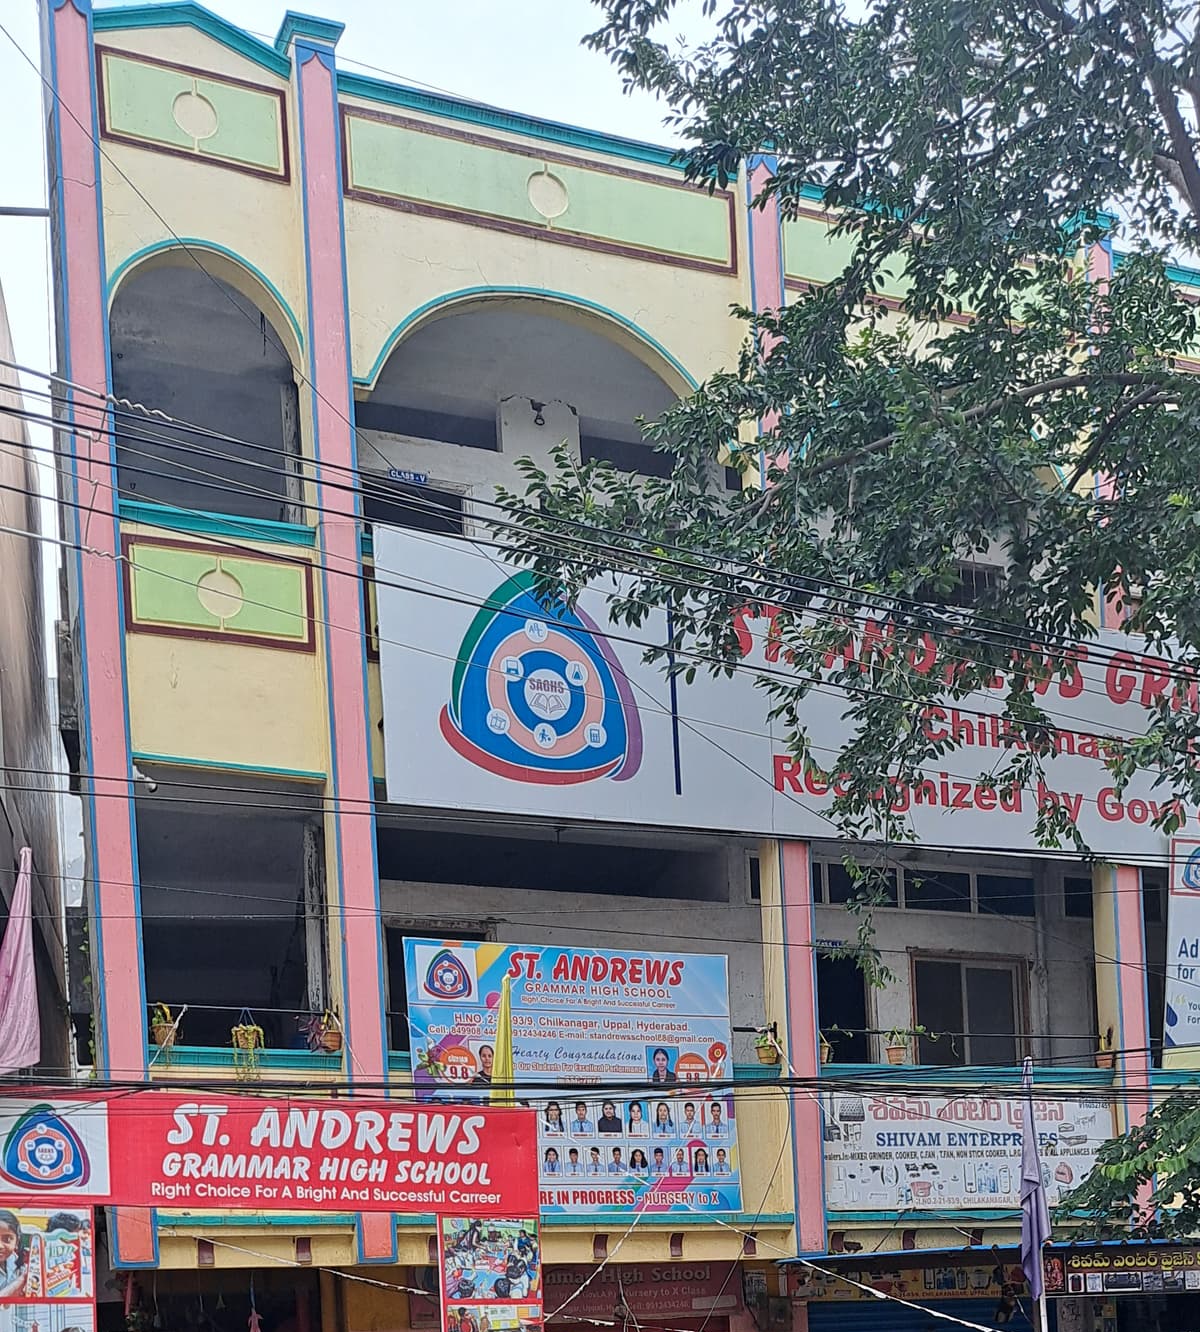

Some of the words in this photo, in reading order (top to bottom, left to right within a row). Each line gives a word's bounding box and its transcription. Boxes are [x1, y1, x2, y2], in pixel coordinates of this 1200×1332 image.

[773, 754, 1023, 814] Recgnized
[508, 952, 542, 980] ST.
[553, 954, 684, 986] ANDREWS
[1177, 963, 1196, 980] for
[525, 983, 585, 995] GRAMMAR
[591, 986, 619, 996] HIGH
[624, 987, 672, 999] SCHOOL
[167, 1103, 230, 1146] ST.
[251, 1105, 485, 1155] ANDREWS
[876, 1132, 941, 1147] SHIVAM
[949, 1132, 1058, 1148] ENTERPRES
[162, 1152, 311, 1182] GRAMMAR
[319, 1157, 388, 1182] HIGH
[395, 1160, 491, 1185] SCHOOL
[151, 1182, 191, 1200] Right
[195, 1182, 251, 1198] Choice
[255, 1184, 278, 1198] For
[281, 1186, 292, 1199] A
[296, 1186, 337, 1204] Bright
[340, 1186, 370, 1200] And
[373, 1189, 445, 1204] Successful
[449, 1190, 501, 1204] Carreer
[539, 1191, 554, 1205] RE
[557, 1191, 570, 1205] IN
[572, 1190, 635, 1205] PROGRESS
[644, 1191, 695, 1205] NURSERY
[698, 1192, 707, 1204] to
[711, 1192, 719, 1204] X
[651, 1265, 711, 1282] School
